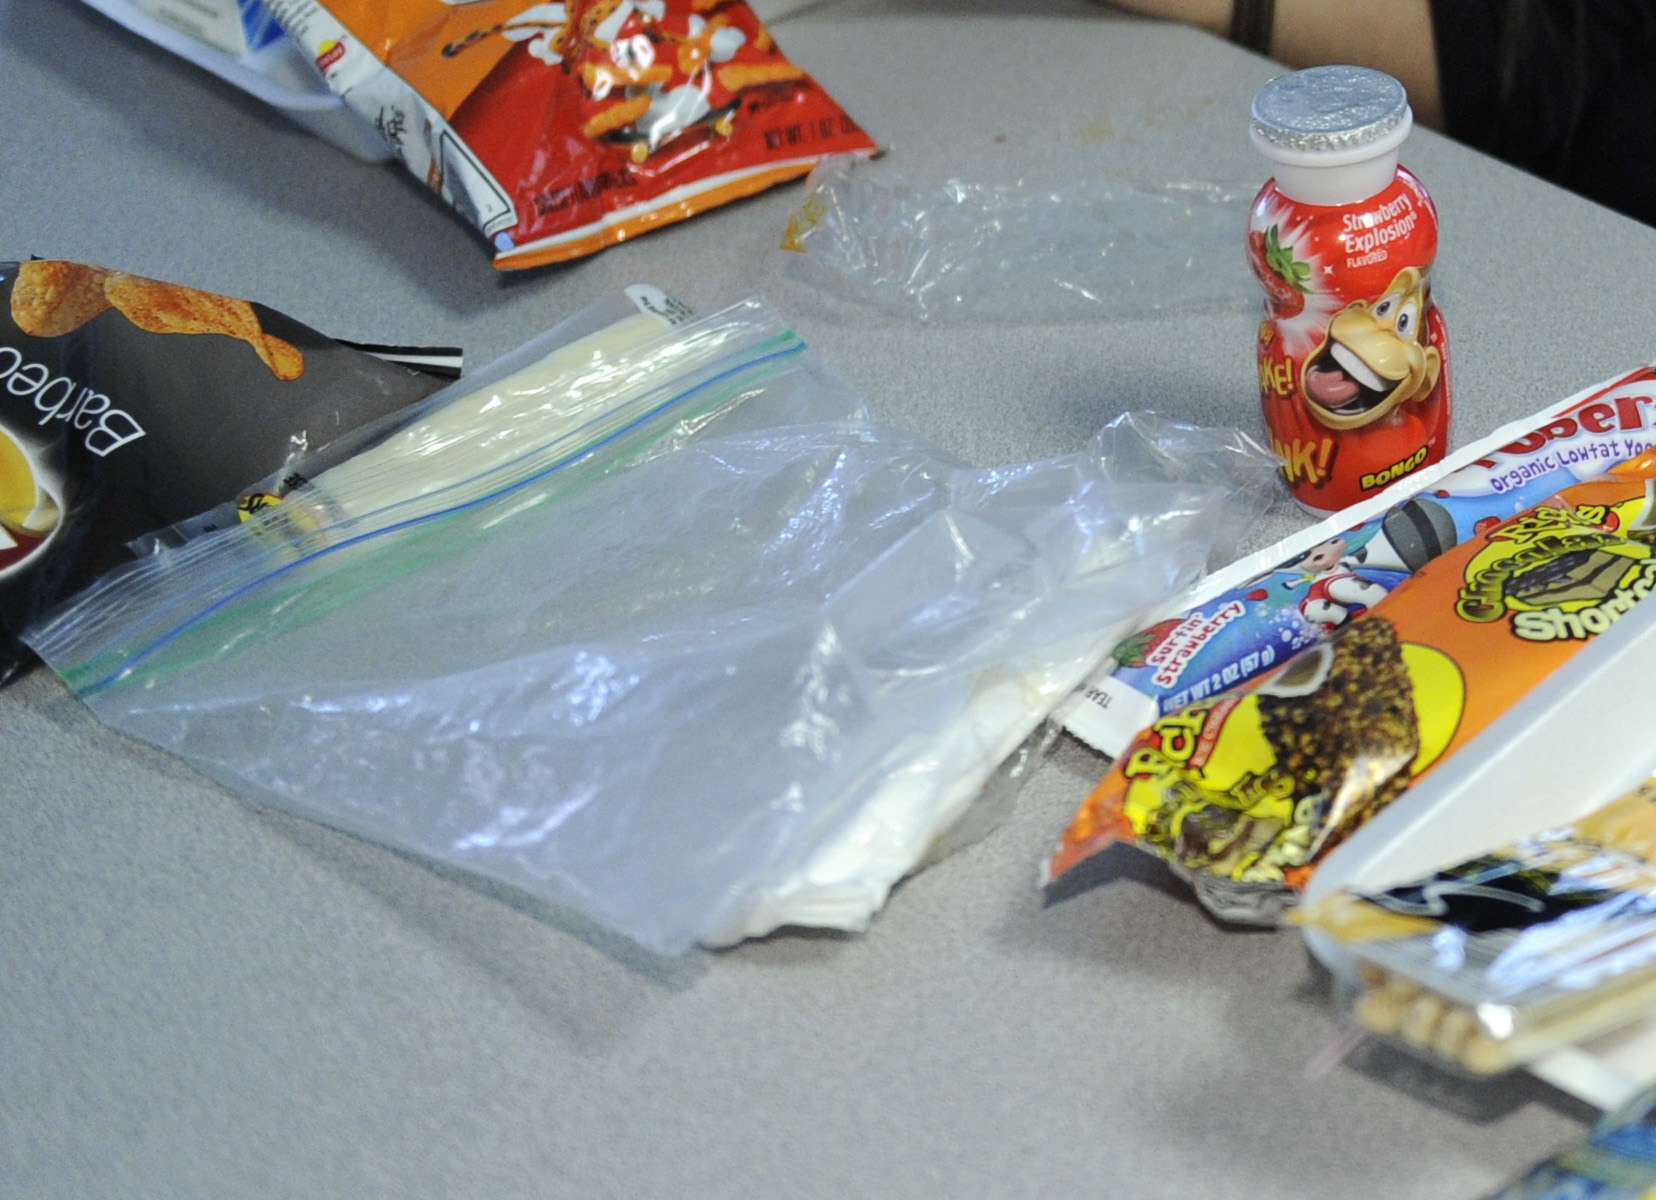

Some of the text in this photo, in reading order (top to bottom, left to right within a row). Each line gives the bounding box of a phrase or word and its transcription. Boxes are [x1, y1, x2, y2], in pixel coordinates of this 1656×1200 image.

[1342, 193, 1413, 233] Strwberry
[1346, 249, 1388, 268] FLAVORED
[1361, 445, 1429, 491] BONGO
[1190, 680, 1212, 703] WT
[1212, 673, 1222, 691] 2
[1222, 662, 1240, 684] OZ
